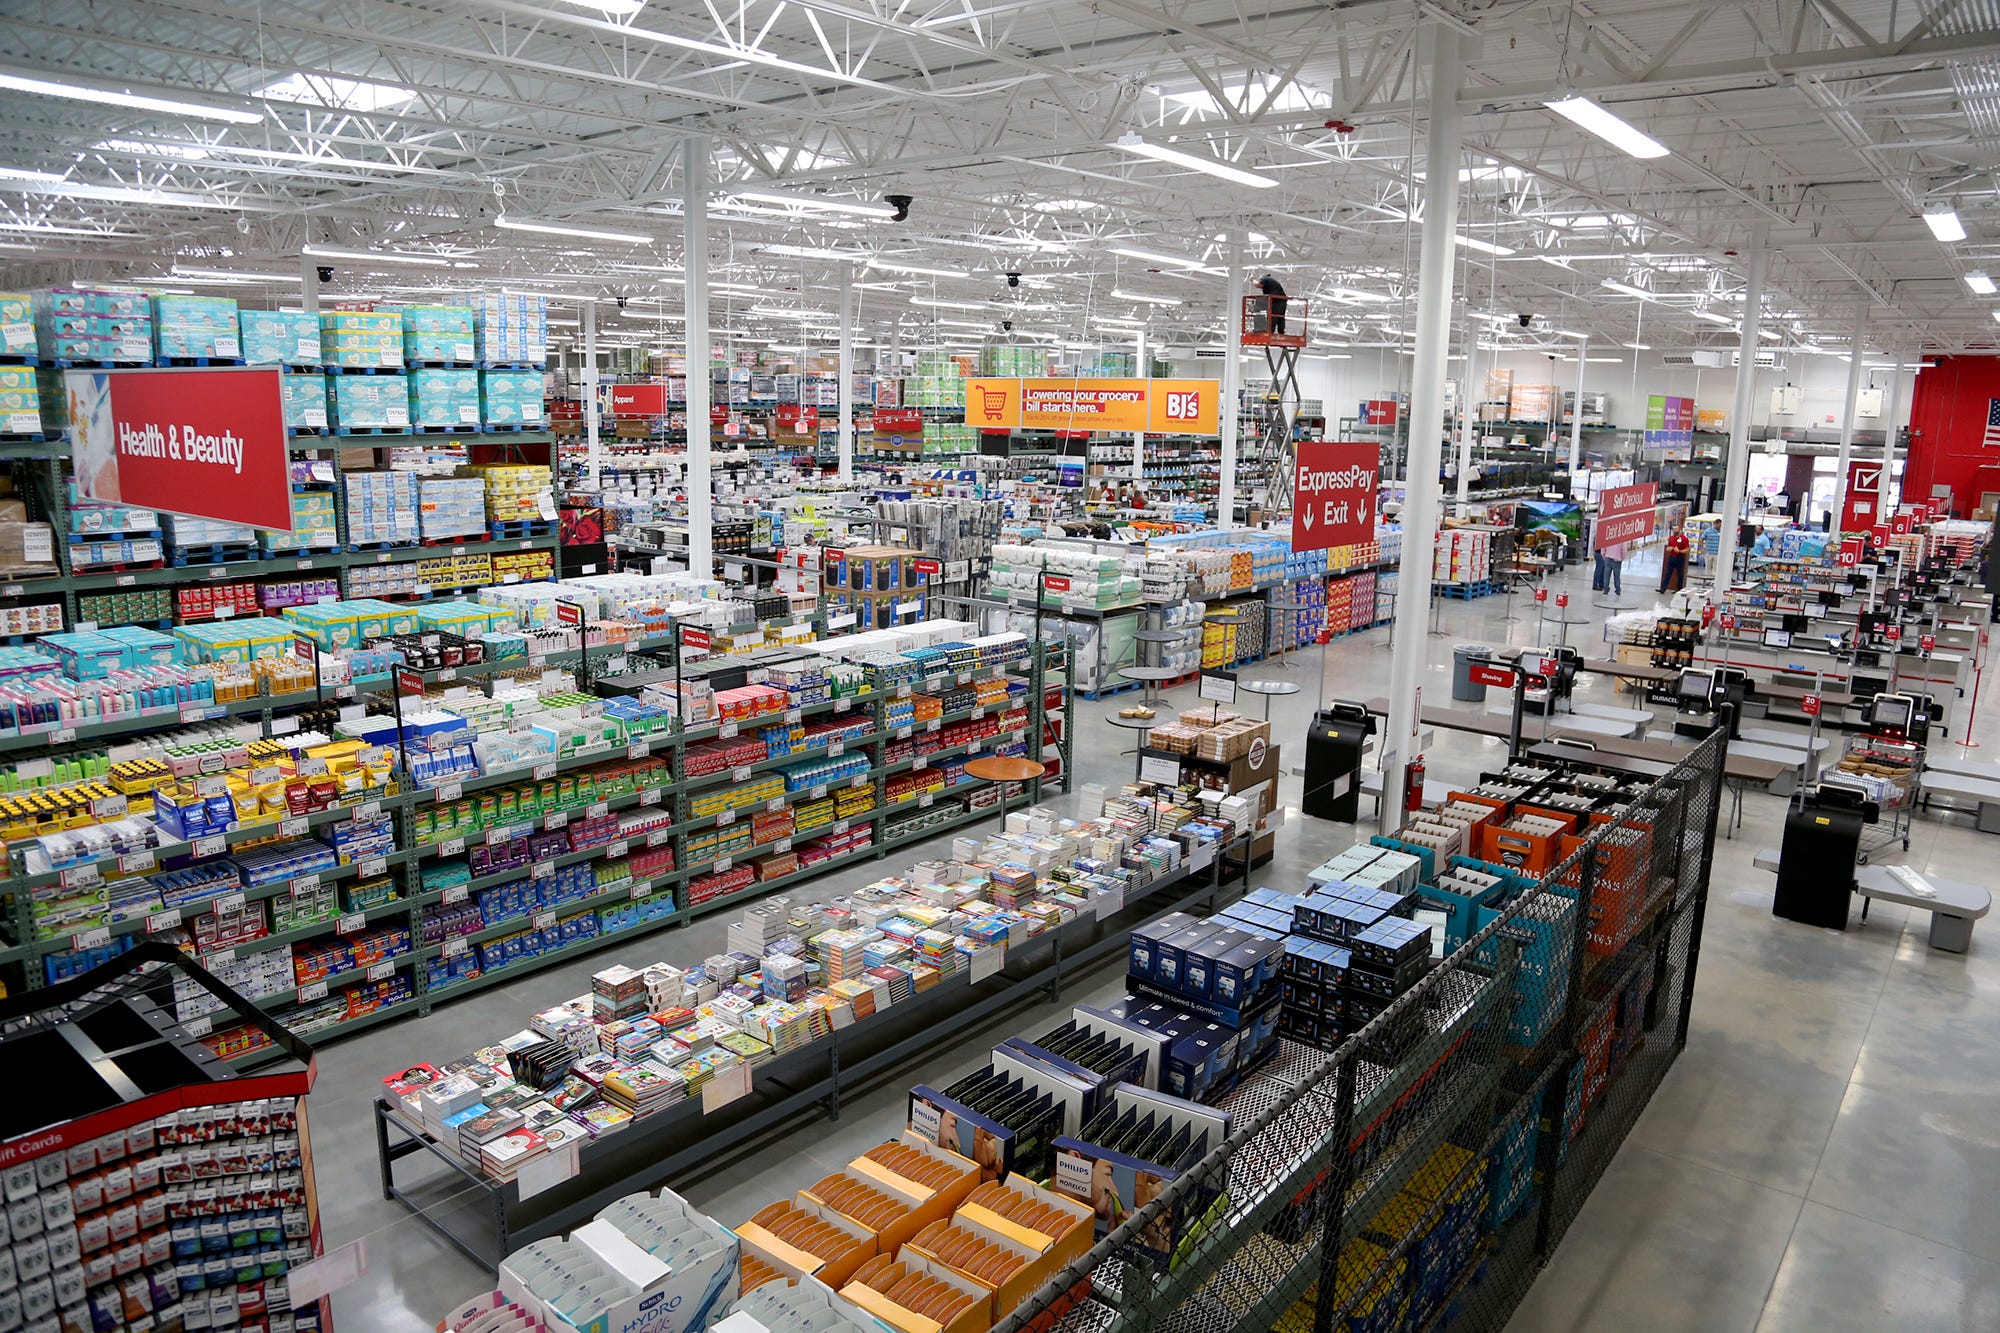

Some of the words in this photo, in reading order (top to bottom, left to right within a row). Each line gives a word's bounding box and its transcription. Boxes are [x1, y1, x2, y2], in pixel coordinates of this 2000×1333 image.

[614, 395, 634, 404] Apparel
[1026, 388, 1072, 402] Lowering
[1074, 391, 1096, 402] your
[1098, 391, 1139, 404] grocery
[1026, 401, 1041, 412] bill
[1042, 402, 1071, 412] starts
[1073, 402, 1099, 413] here.
[1167, 390, 1198, 418] BJ's
[119, 421, 166, 459] Health
[168, 423, 182, 460] &
[183, 425, 244, 474] Beauty
[1299, 464, 1374, 496] ExpressPay
[1614, 494, 1623, 509] Self
[1623, 492, 1644, 507] Checkout
[1324, 500, 1348, 526] Exit
[1928, 506, 1935, 514] 2
[1913, 515, 1920, 523] 4
[1606, 524, 1618, 540] Debit
[1622, 520, 1634, 536] Credit
[1634, 517, 1646, 534] Only
[1896, 523, 1904, 533] 6
[1873, 535, 1882, 546] 8
[1840, 552, 1854, 564] 10
[1481, 672, 1502, 683] Shaving
[290, 788, 308, 796] HALLS
[448, 846, 464, 854] $7.99
[301, 882, 320, 892] $22.99
[225, 901, 246, 912] $22.99
[301, 972, 320, 982] DayQuil
[1138, 984, 1164, 998] Ultimate
[1164, 991, 1170, 999] in
[1170, 995, 1190, 1007] speed
[354, 1004, 374, 1014] DayQuil
[914, 1107, 938, 1125] PHILIPS
[0, 1147, 16, 1160] ift
[20, 1134, 64, 1154] Cards
[1059, 1160, 1088, 1176] PHILIPS
[1058, 1178, 1087, 1193] NORELCO
[641, 1296, 662, 1309] Schick
[622, 1296, 682, 1333] HYDRO
[640, 1316, 672, 1333] Silk
